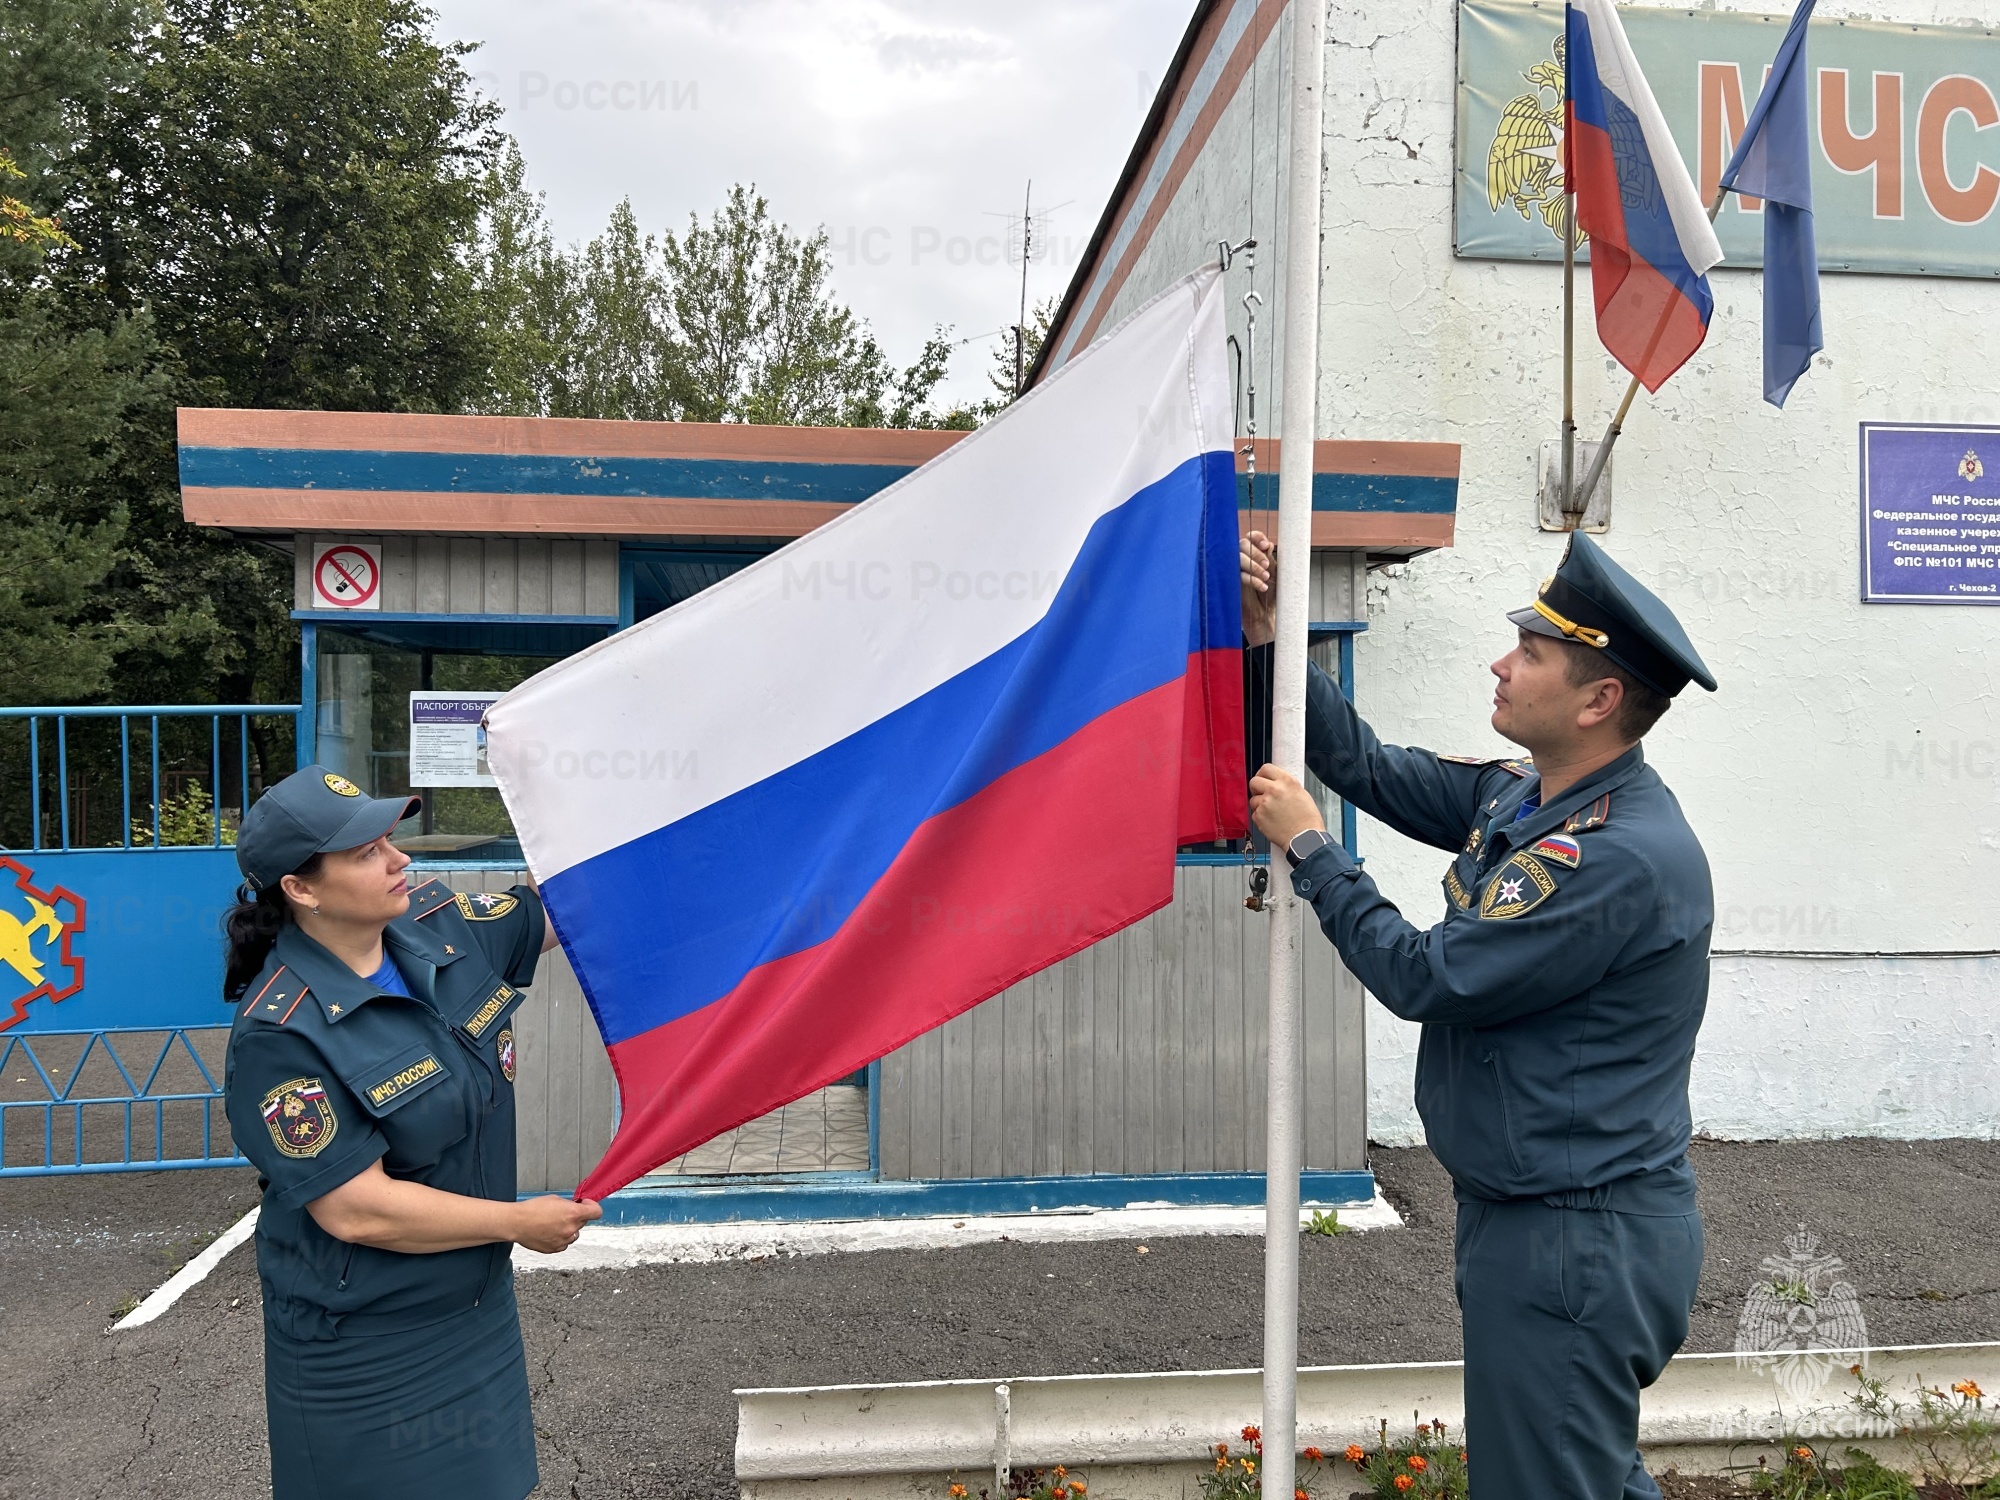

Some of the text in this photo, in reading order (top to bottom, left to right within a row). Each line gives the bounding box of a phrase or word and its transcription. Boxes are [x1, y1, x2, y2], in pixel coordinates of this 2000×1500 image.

[1697, 60, 2000, 227] МЧС
[1932, 495, 1960, 505] МЧС
[1873, 510, 1958, 521] Федеральное
[1897, 527, 1957, 536] казенное
[1894, 557, 1923, 566] ФПС
[1926, 558, 1962, 567] №101
[1966, 558, 1994, 567] МЧС
[1959, 584, 1996, 592] Чехов-2
[416, 702, 495, 711] ПАСПОРТ ОБЪЕК
[1540, 846, 1569, 860] РОССИЯ
[1515, 855, 1552, 893] МЧС РОССИИ
[466, 997, 503, 1035] ЛУКАШОВА
[371, 1081, 397, 1103] МЧС
[393, 1058, 438, 1090] РОССИИ
